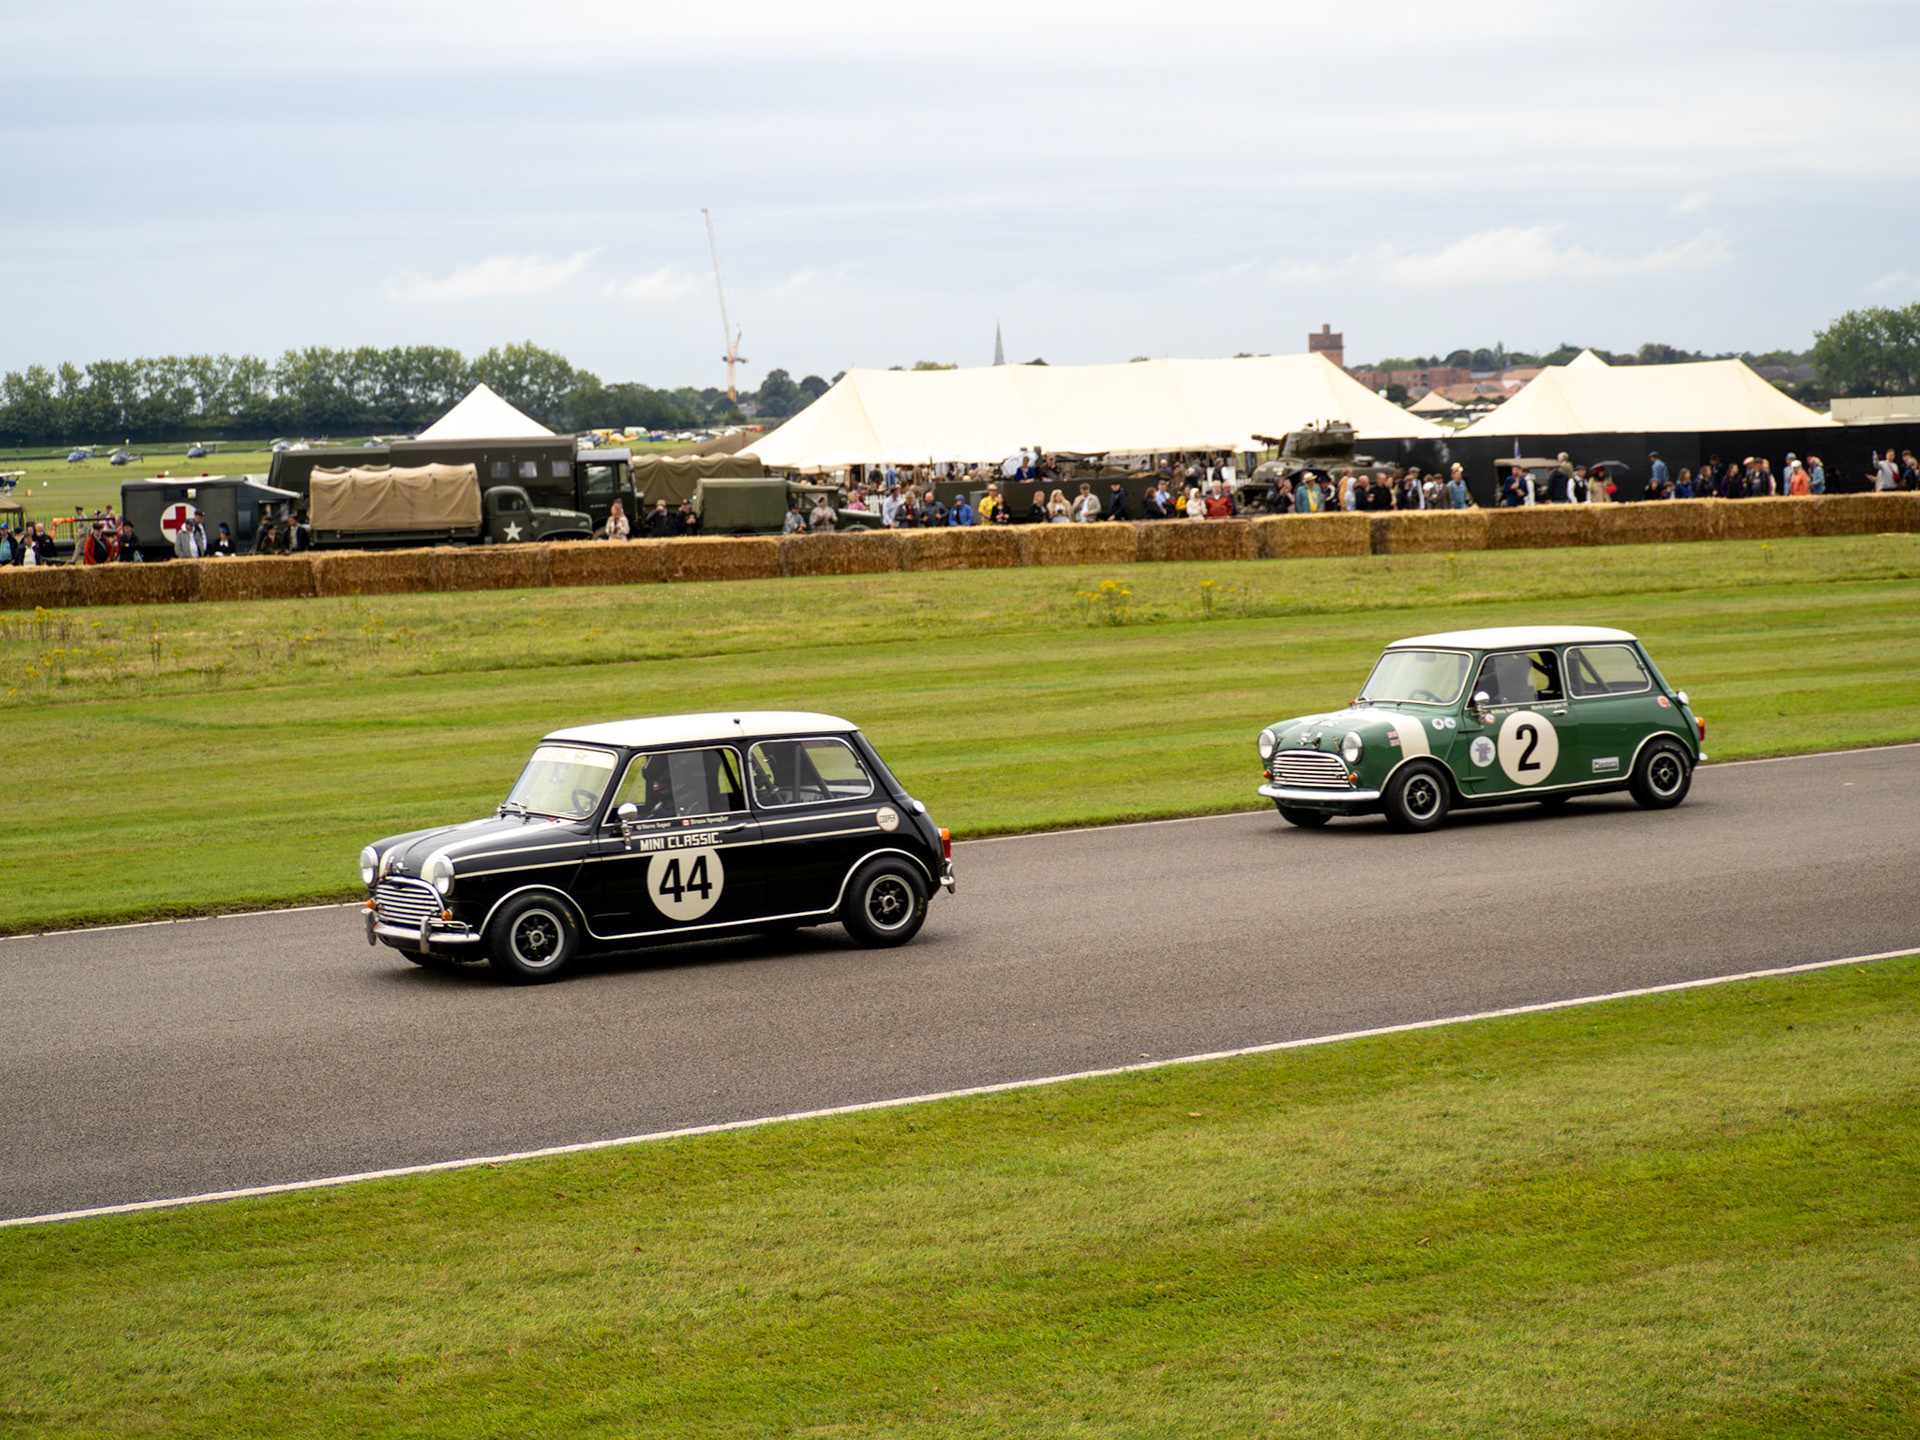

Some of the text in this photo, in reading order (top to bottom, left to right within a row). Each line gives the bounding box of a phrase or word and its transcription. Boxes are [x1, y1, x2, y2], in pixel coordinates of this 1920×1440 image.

[1516, 724, 1541, 771] 2
[640, 838, 665, 852] MINI
[659, 855, 713, 903] 44
